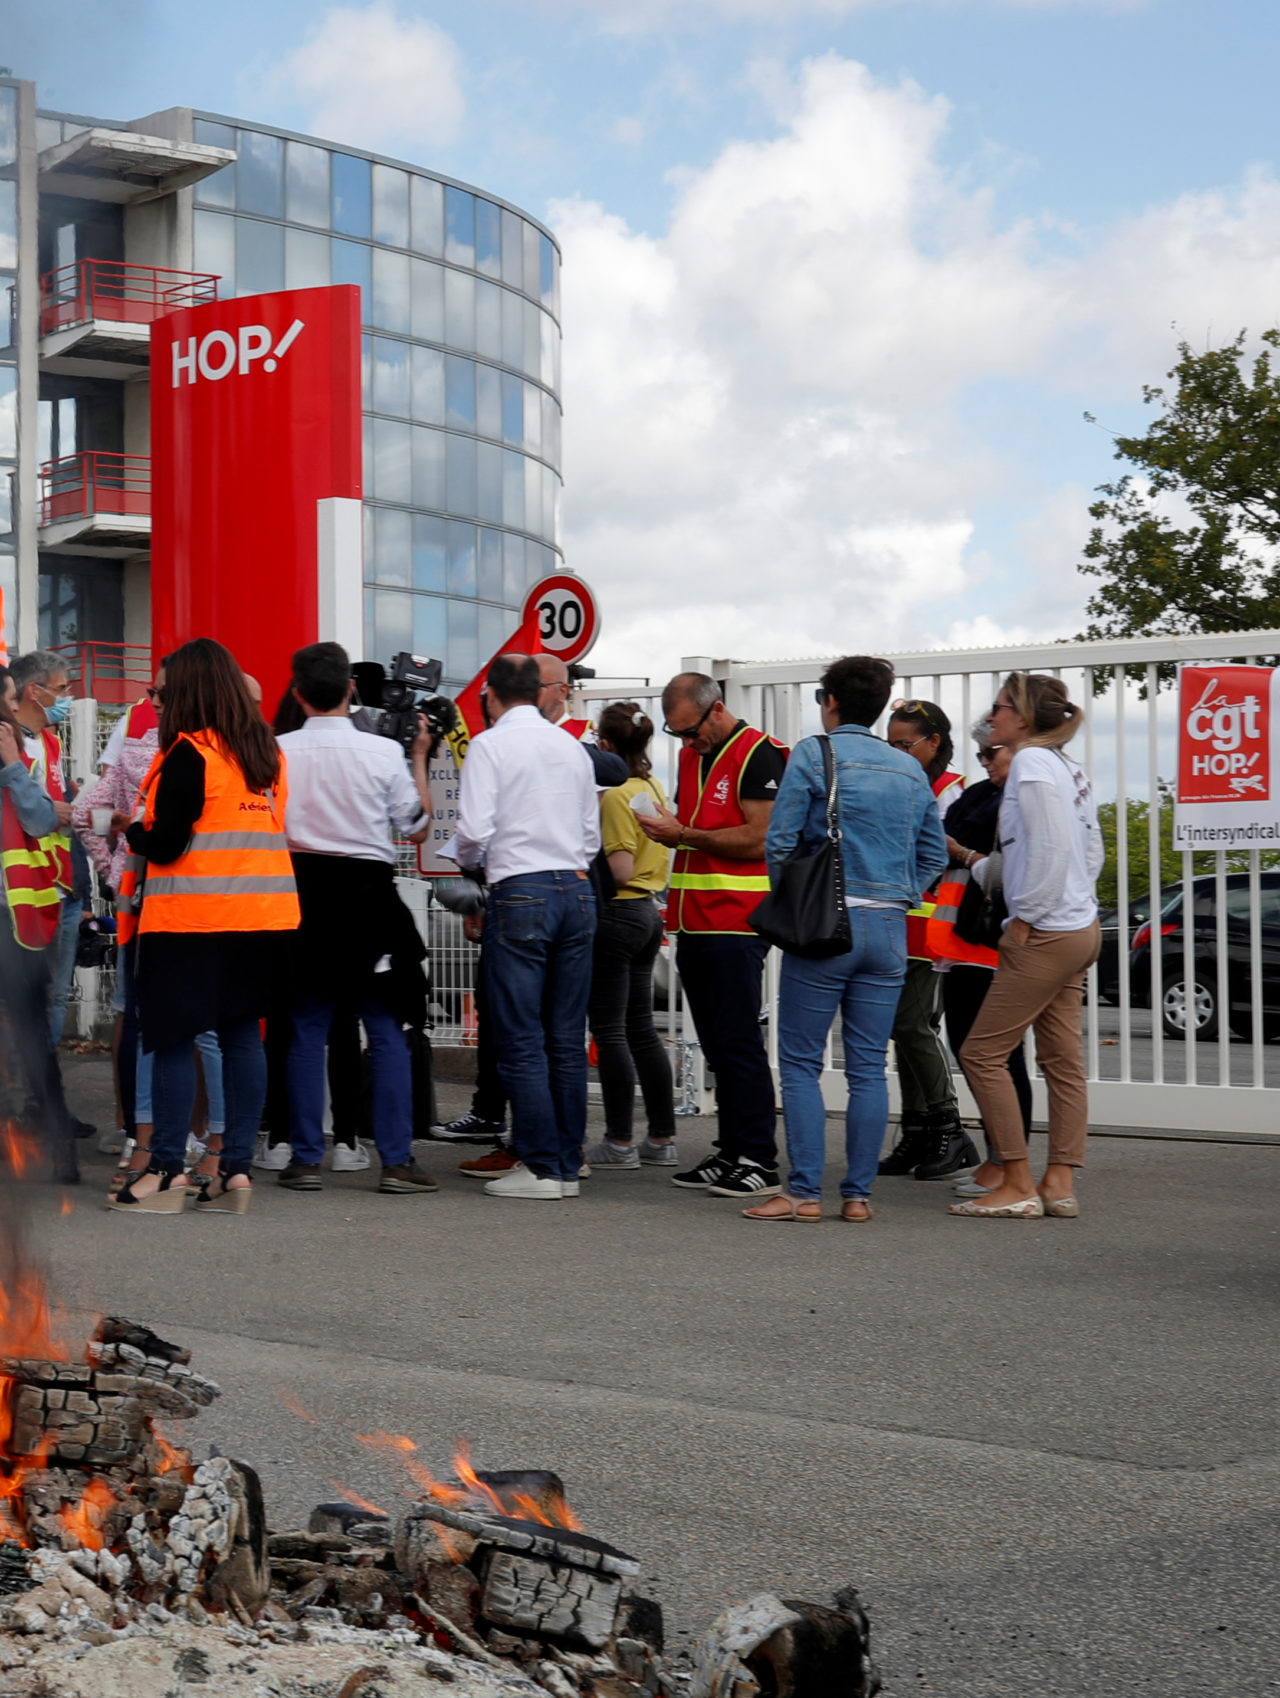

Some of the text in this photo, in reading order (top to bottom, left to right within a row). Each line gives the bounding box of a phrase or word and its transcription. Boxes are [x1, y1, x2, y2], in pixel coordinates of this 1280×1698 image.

[171, 318, 306, 388] HOP!
[538, 601, 582, 640] 30
[1186, 696, 1261, 751] cgt
[1192, 752, 1260, 776] HOP!
